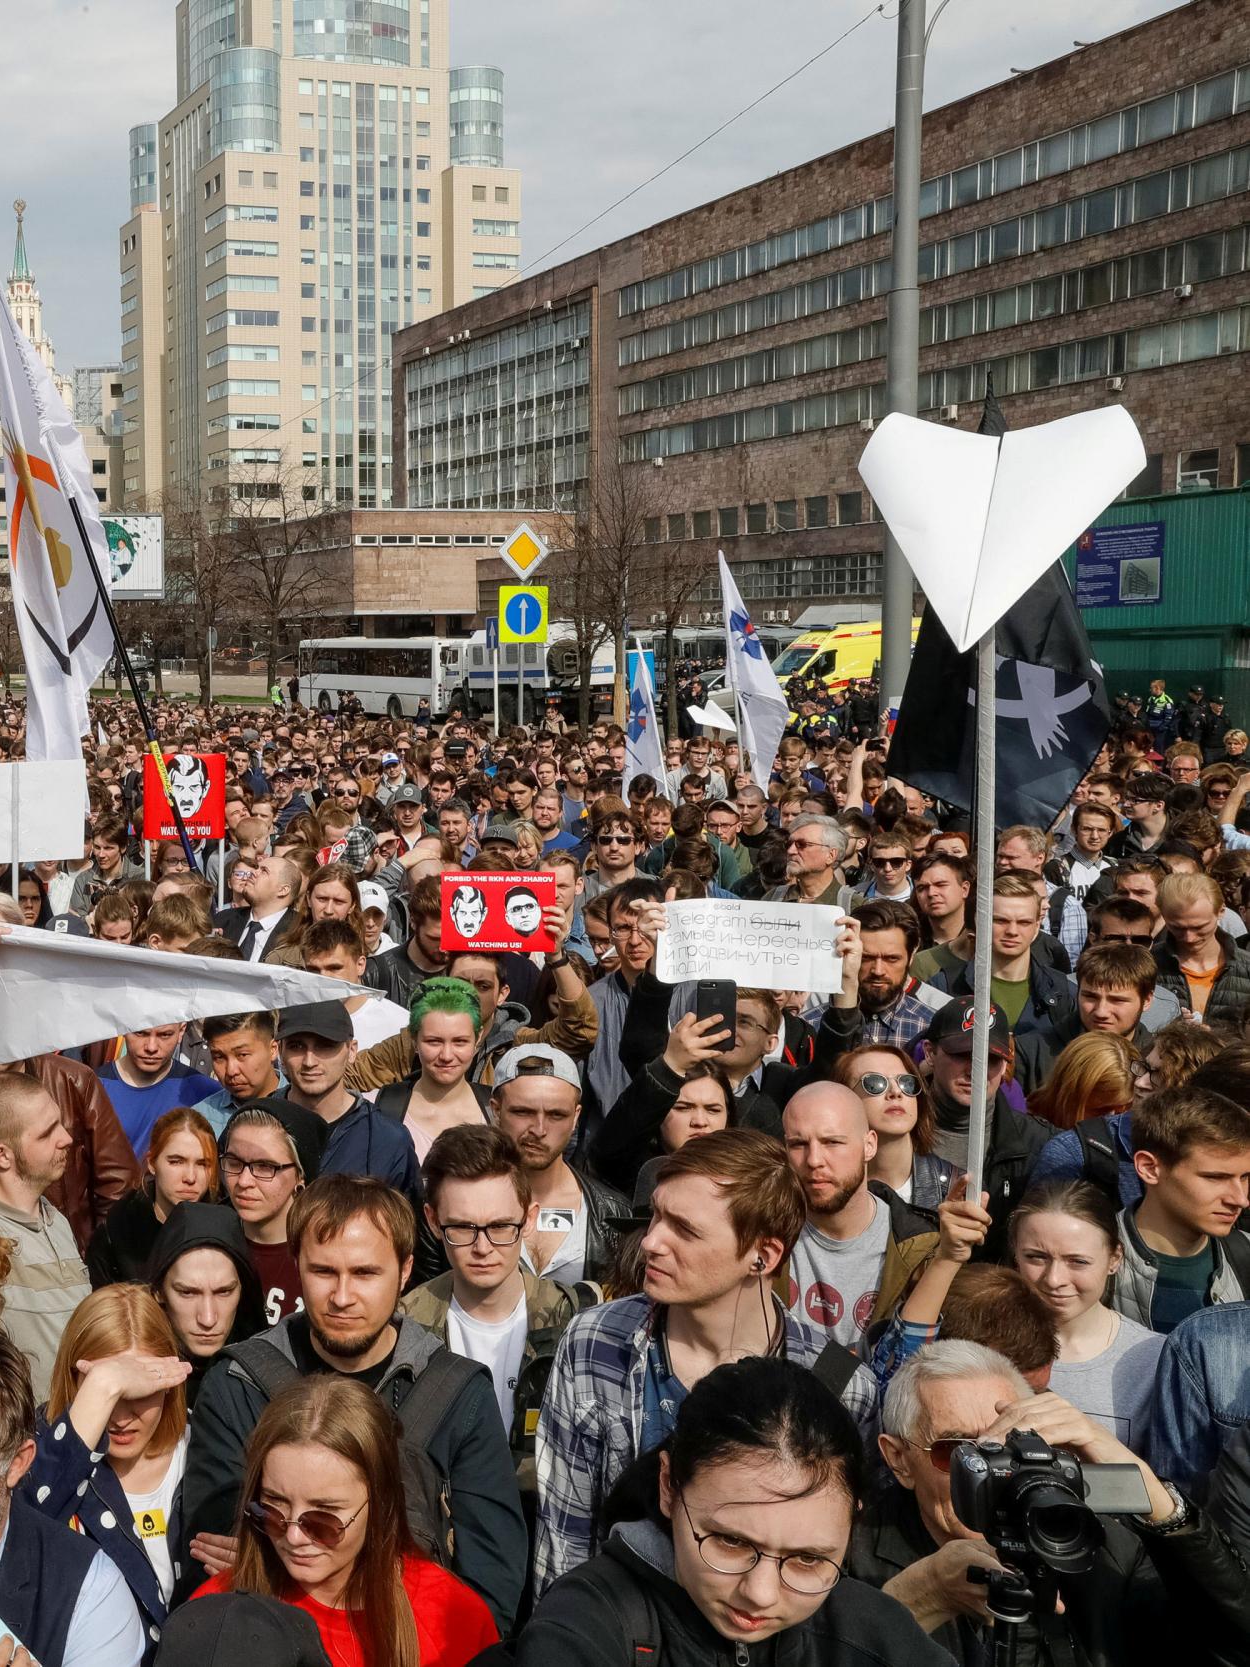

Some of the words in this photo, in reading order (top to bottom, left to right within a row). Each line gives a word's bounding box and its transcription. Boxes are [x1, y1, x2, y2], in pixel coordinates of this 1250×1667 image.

[161, 826, 195, 836] WATCNG
[197, 826, 211, 836] YOU
[522, 875, 554, 883] ZHAROV
[675, 912, 747, 931] Telegram
[750, 912, 801, 931] были
[666, 929, 716, 946] самые
[468, 941, 508, 949] WATCHING
[509, 941, 522, 949] US!
[665, 948, 675, 961] и
[678, 944, 800, 966] продвинутые
[1001, 1540, 1026, 1548] SLIK
